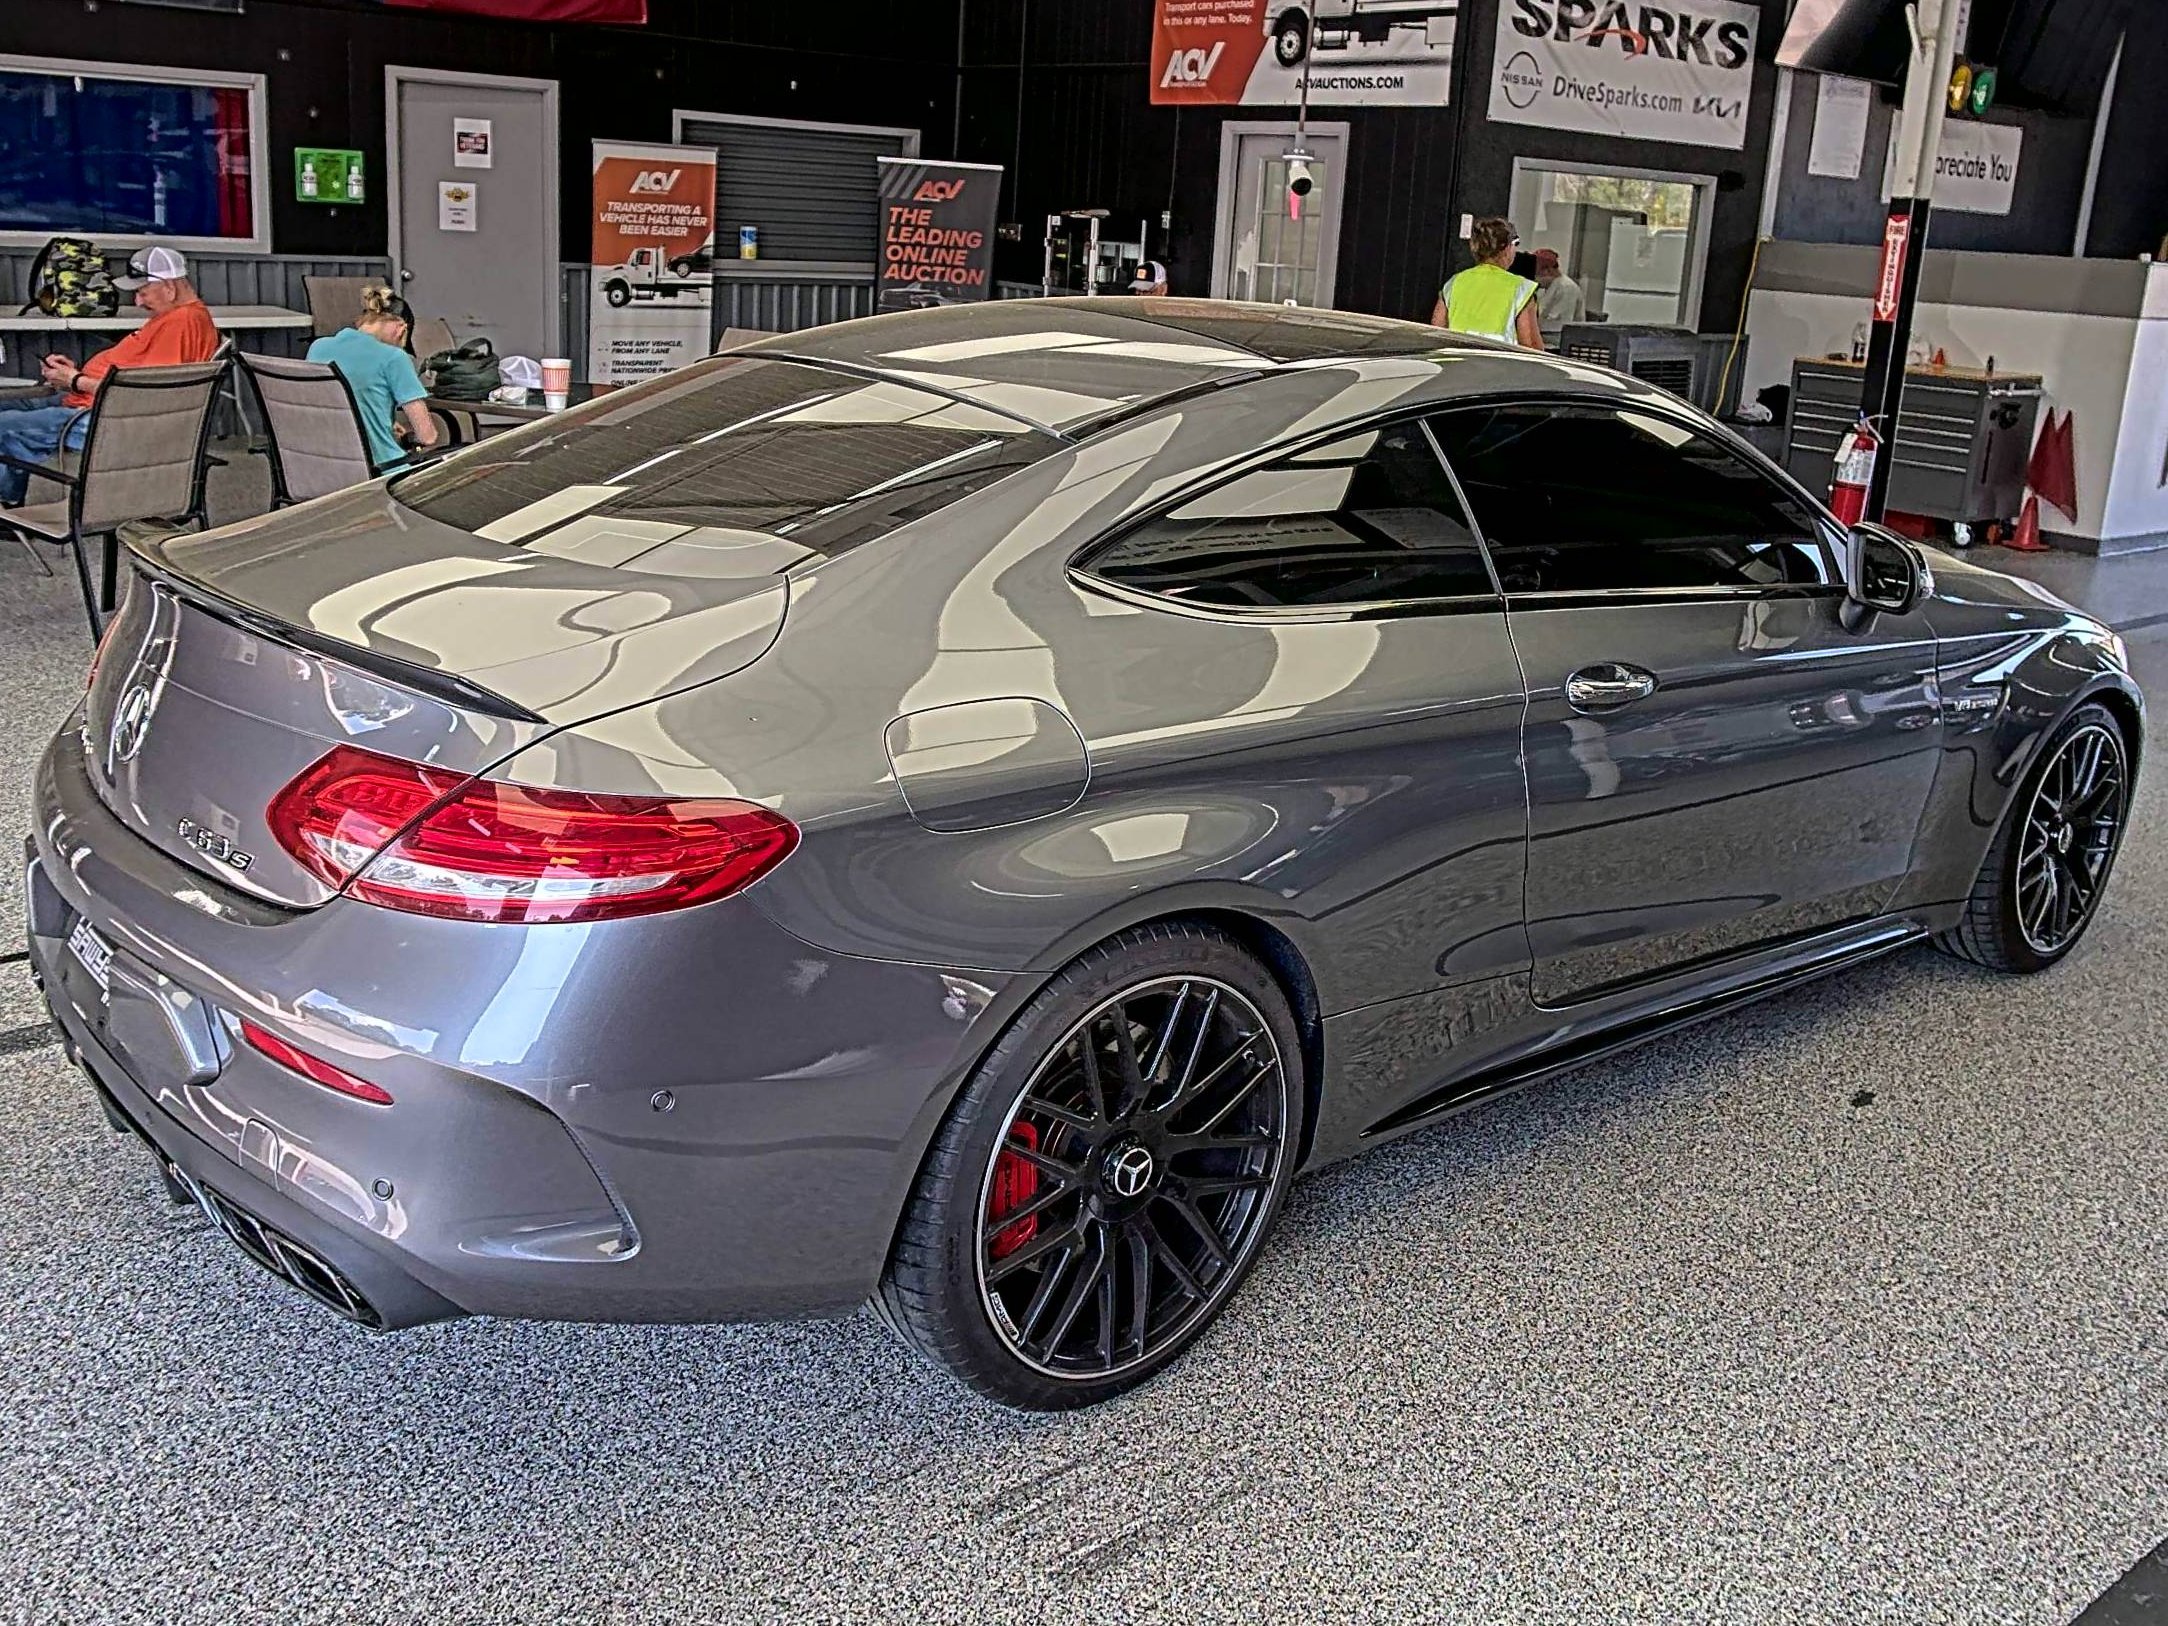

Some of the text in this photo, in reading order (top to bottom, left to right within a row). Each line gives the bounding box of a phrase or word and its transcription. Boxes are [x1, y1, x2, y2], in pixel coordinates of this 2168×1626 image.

[1165, 0, 1254, 12] Transport cars purchased
[1193, 16, 1207, 26] any
[1228, 13, 1253, 25] Today.
[1511, 0, 1749, 70] SPARKS
[1160, 42, 1226, 88] ACV
[1501, 72, 1543, 87] NISSAN
[1553, 75, 1682, 113] DriveSparks.com
[1991, 154, 2012, 182] You
[629, 169, 682, 194] ACV
[913, 179, 966, 200] ACV
[600, 212, 708, 226] VEHICLE HAS NEVER
[607, 202, 701, 215] TRANSPORTING A
[889, 206, 933, 226] THE
[619, 224, 688, 236] BEEN EASIER
[886, 225, 983, 249] LEADING
[885, 244, 968, 266] ONLINE
[883, 263, 985, 285] AUCTION
